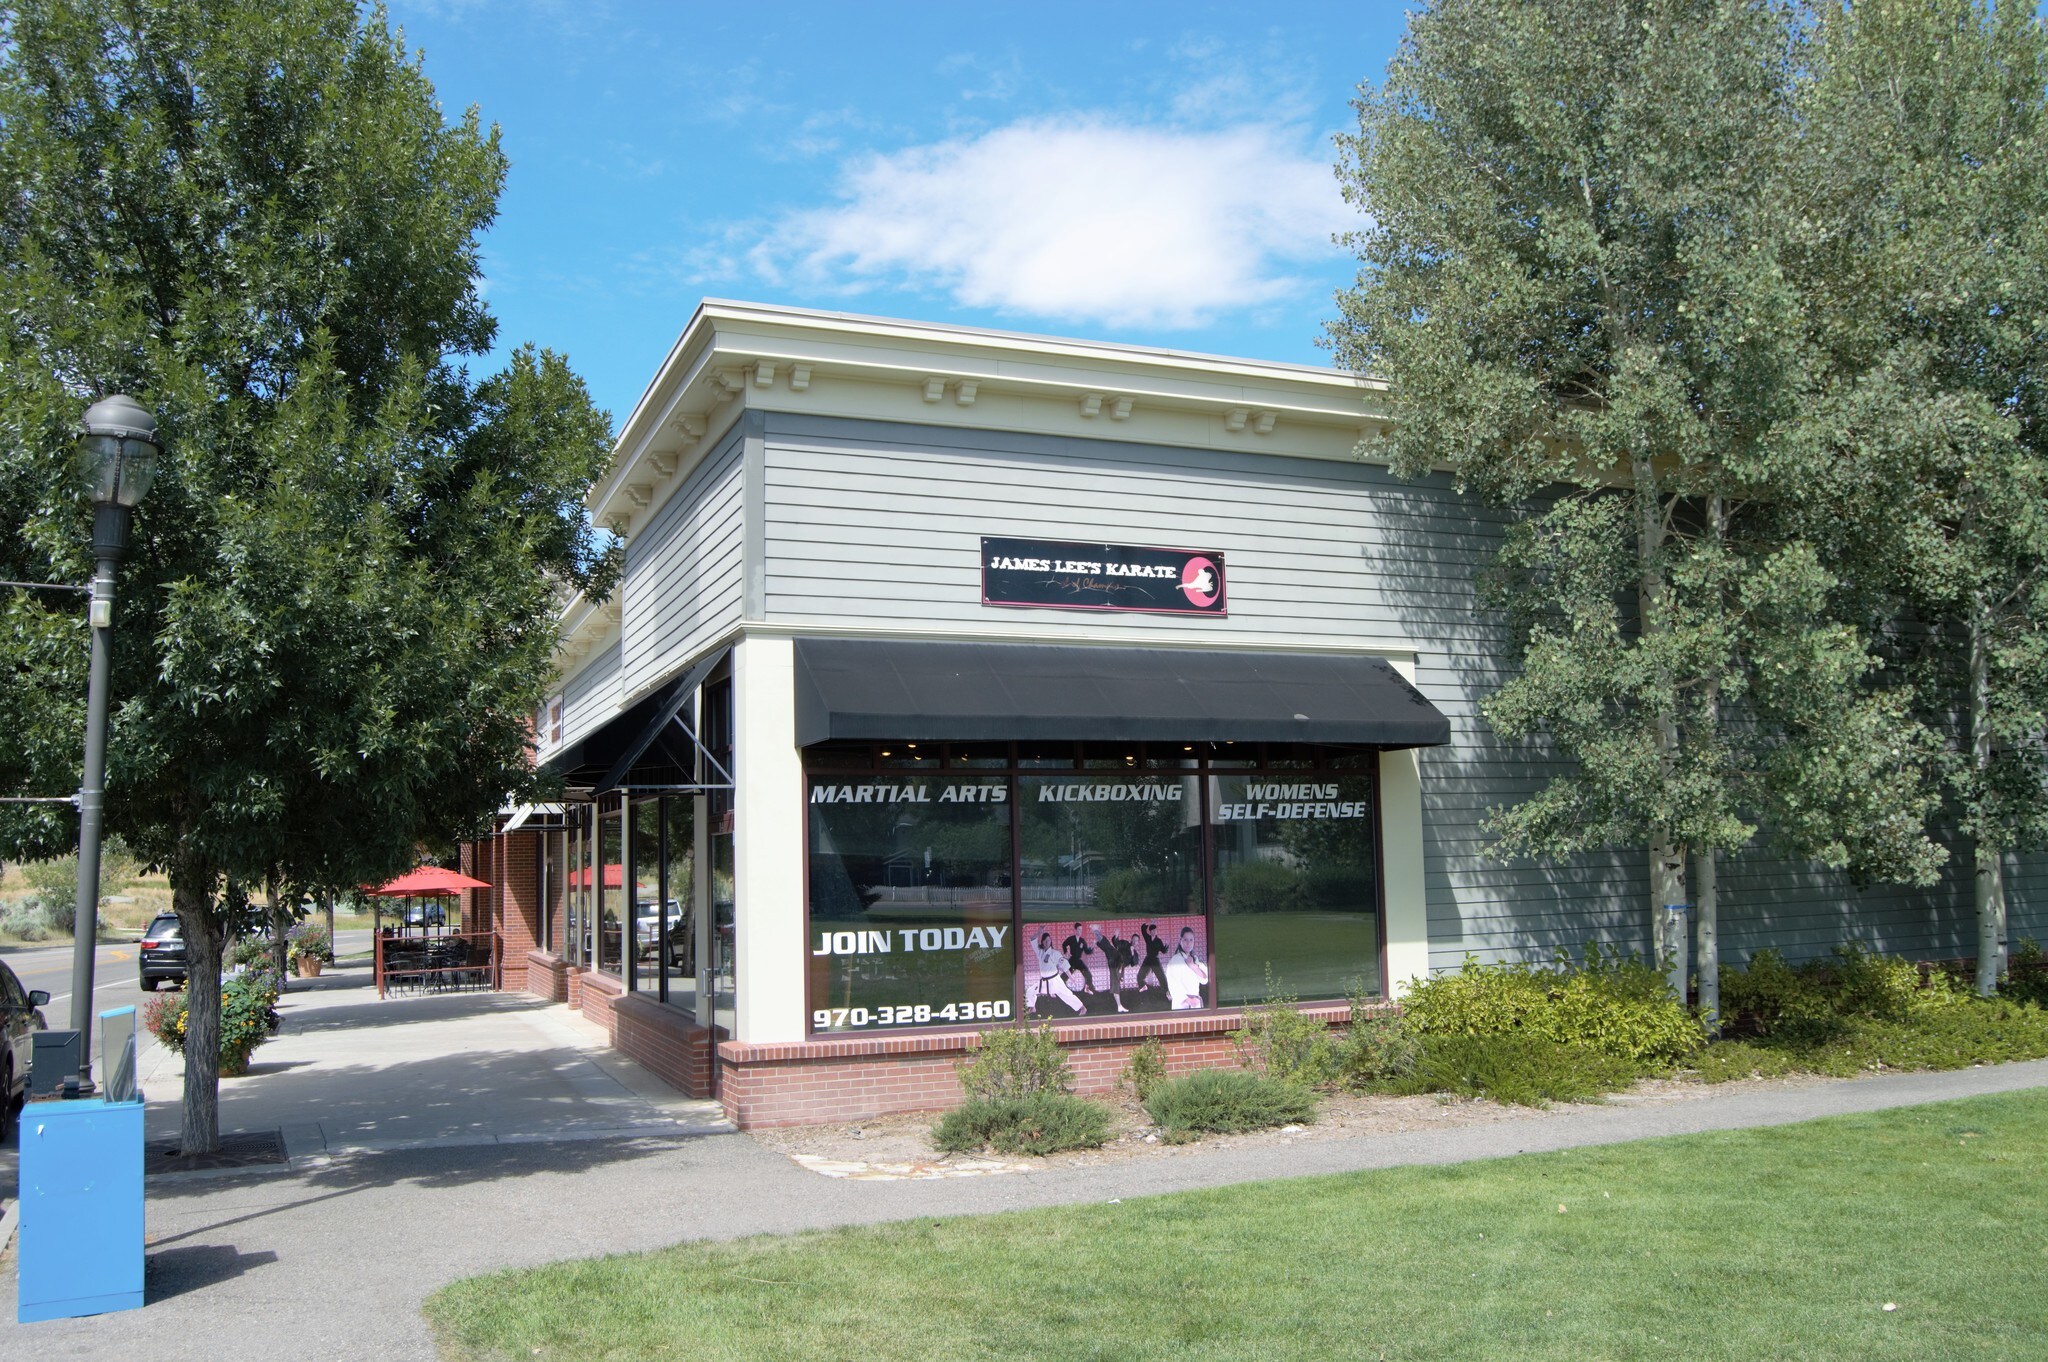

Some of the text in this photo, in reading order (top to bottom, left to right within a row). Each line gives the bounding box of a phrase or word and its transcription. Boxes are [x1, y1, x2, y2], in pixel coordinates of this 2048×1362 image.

[990, 556, 1177, 579] JAMES LEE'S KARATE
[810, 784, 1008, 804] MARTIAL ARTS
[1038, 784, 1183, 802] KICKBOXING
[1246, 783, 1339, 801] WOMENS
[1217, 802, 1366, 820] SELF-DEFENSE
[813, 925, 1009, 956] JOIN TODAY
[813, 999, 1011, 1028] 970-328-4360
